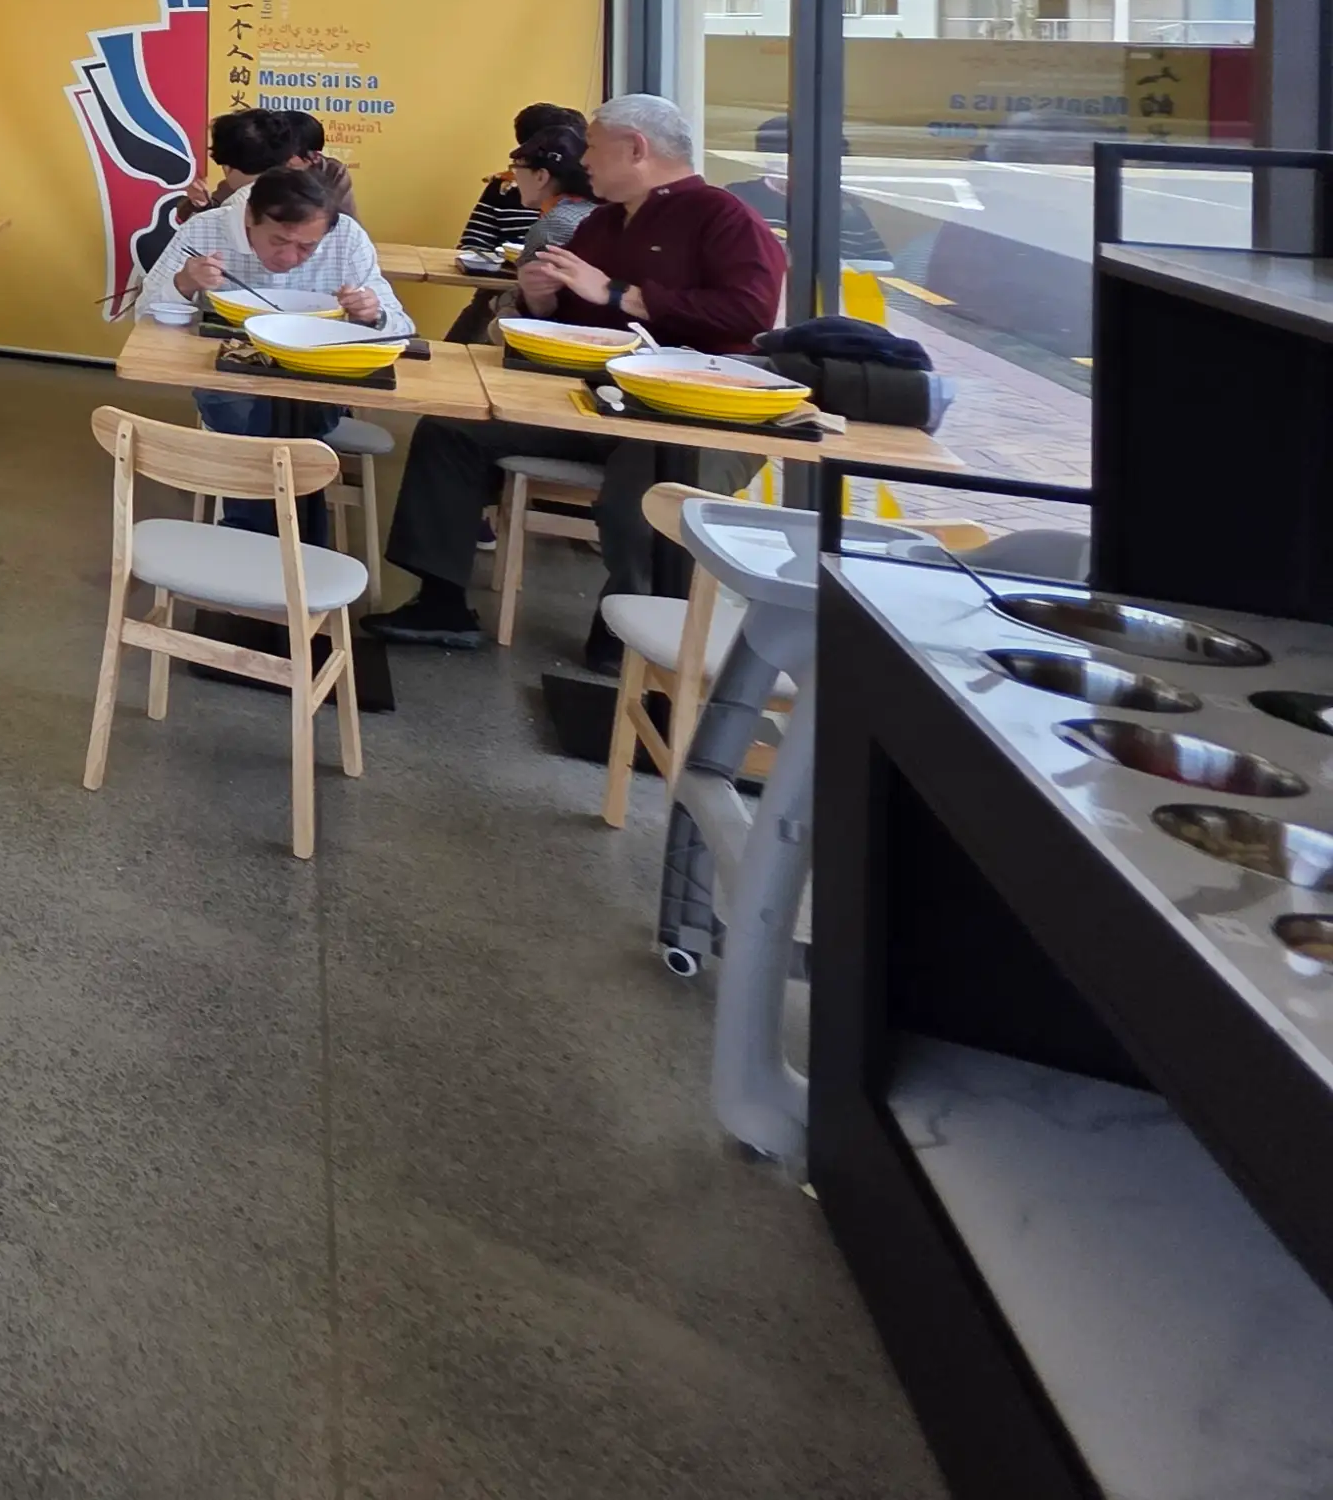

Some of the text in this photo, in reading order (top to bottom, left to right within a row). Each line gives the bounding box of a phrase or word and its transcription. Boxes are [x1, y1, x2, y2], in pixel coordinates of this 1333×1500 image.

[259, 70, 378, 89] Maots'ai is a
[325, 96, 352, 113] for
[358, 100, 395, 114] one
